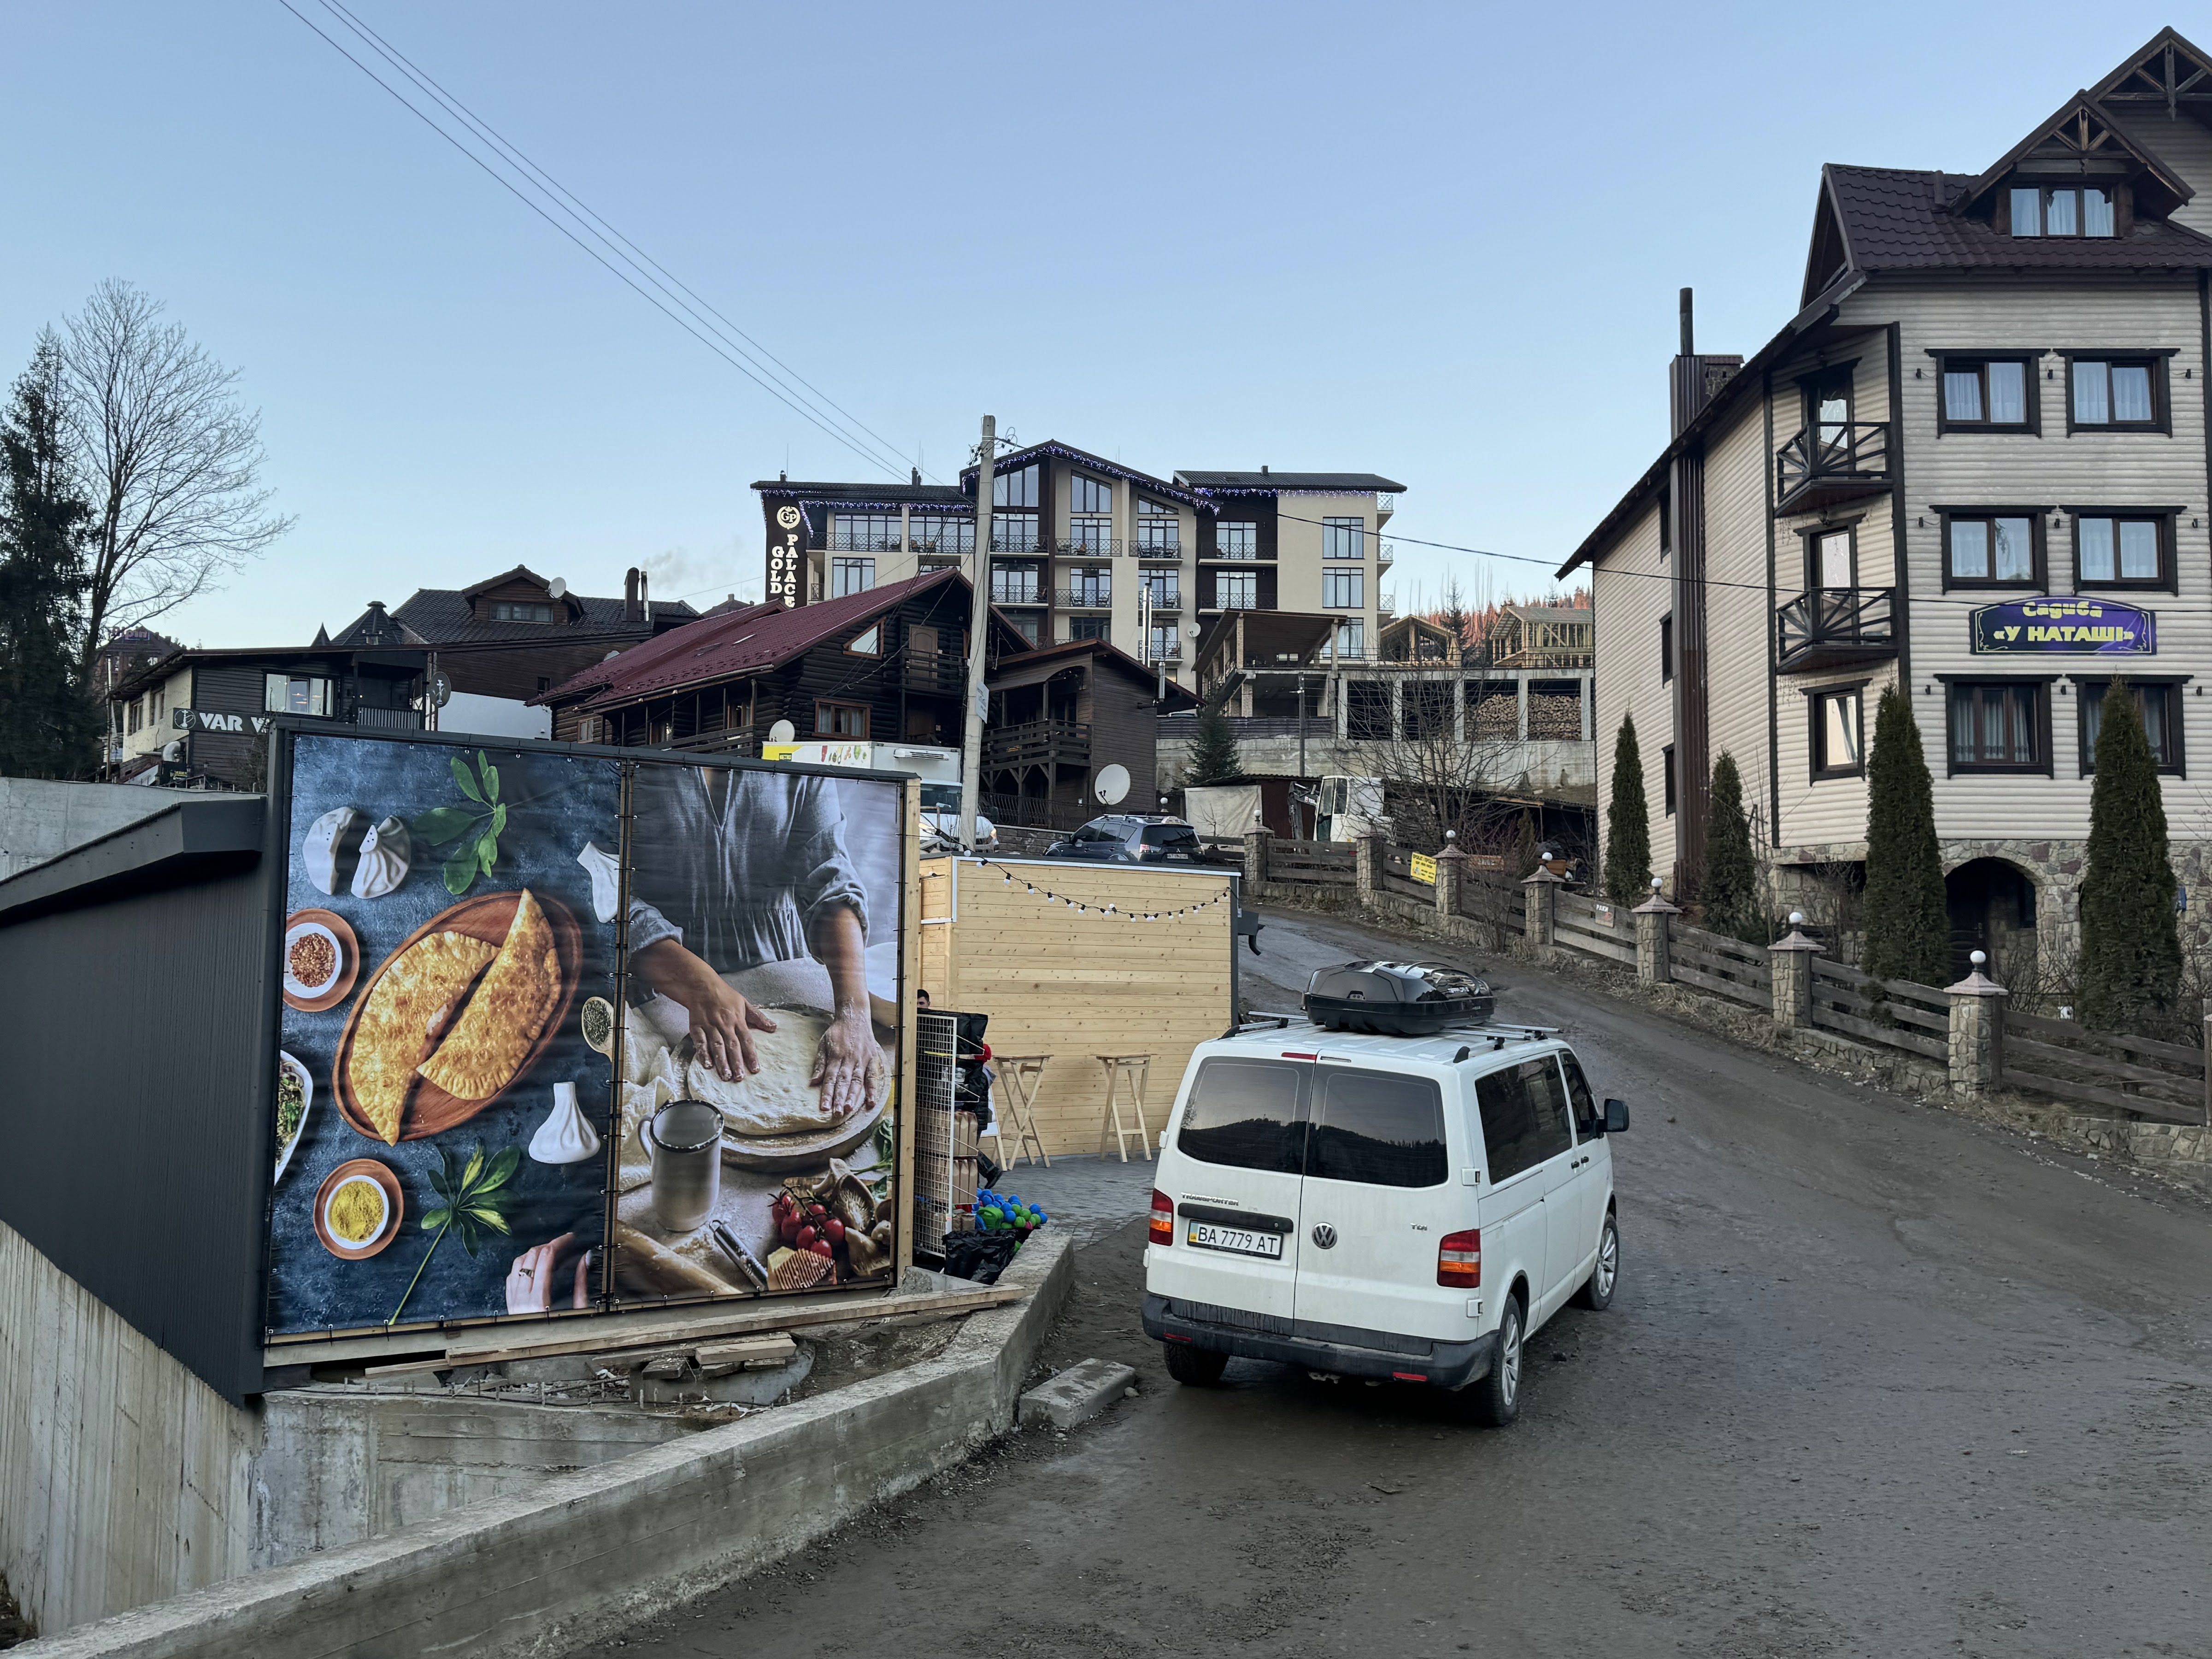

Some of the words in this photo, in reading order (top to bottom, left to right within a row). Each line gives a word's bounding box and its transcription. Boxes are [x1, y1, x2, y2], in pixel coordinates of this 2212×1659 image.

[781, 512, 797, 523] GP
[770, 546, 784, 594] GOLD
[784, 534, 799, 608] PALACE
[2023, 601, 2102, 618] Садиба
[199, 712, 243, 732] VAR
[1181, 1192, 1239, 1206] TRANSPORTER
[1410, 1223, 1428, 1231] TDI
[1198, 1227, 1216, 1243] BA
[1221, 1230, 1252, 1248] 7779
[1257, 1236, 1277, 1253] AT
